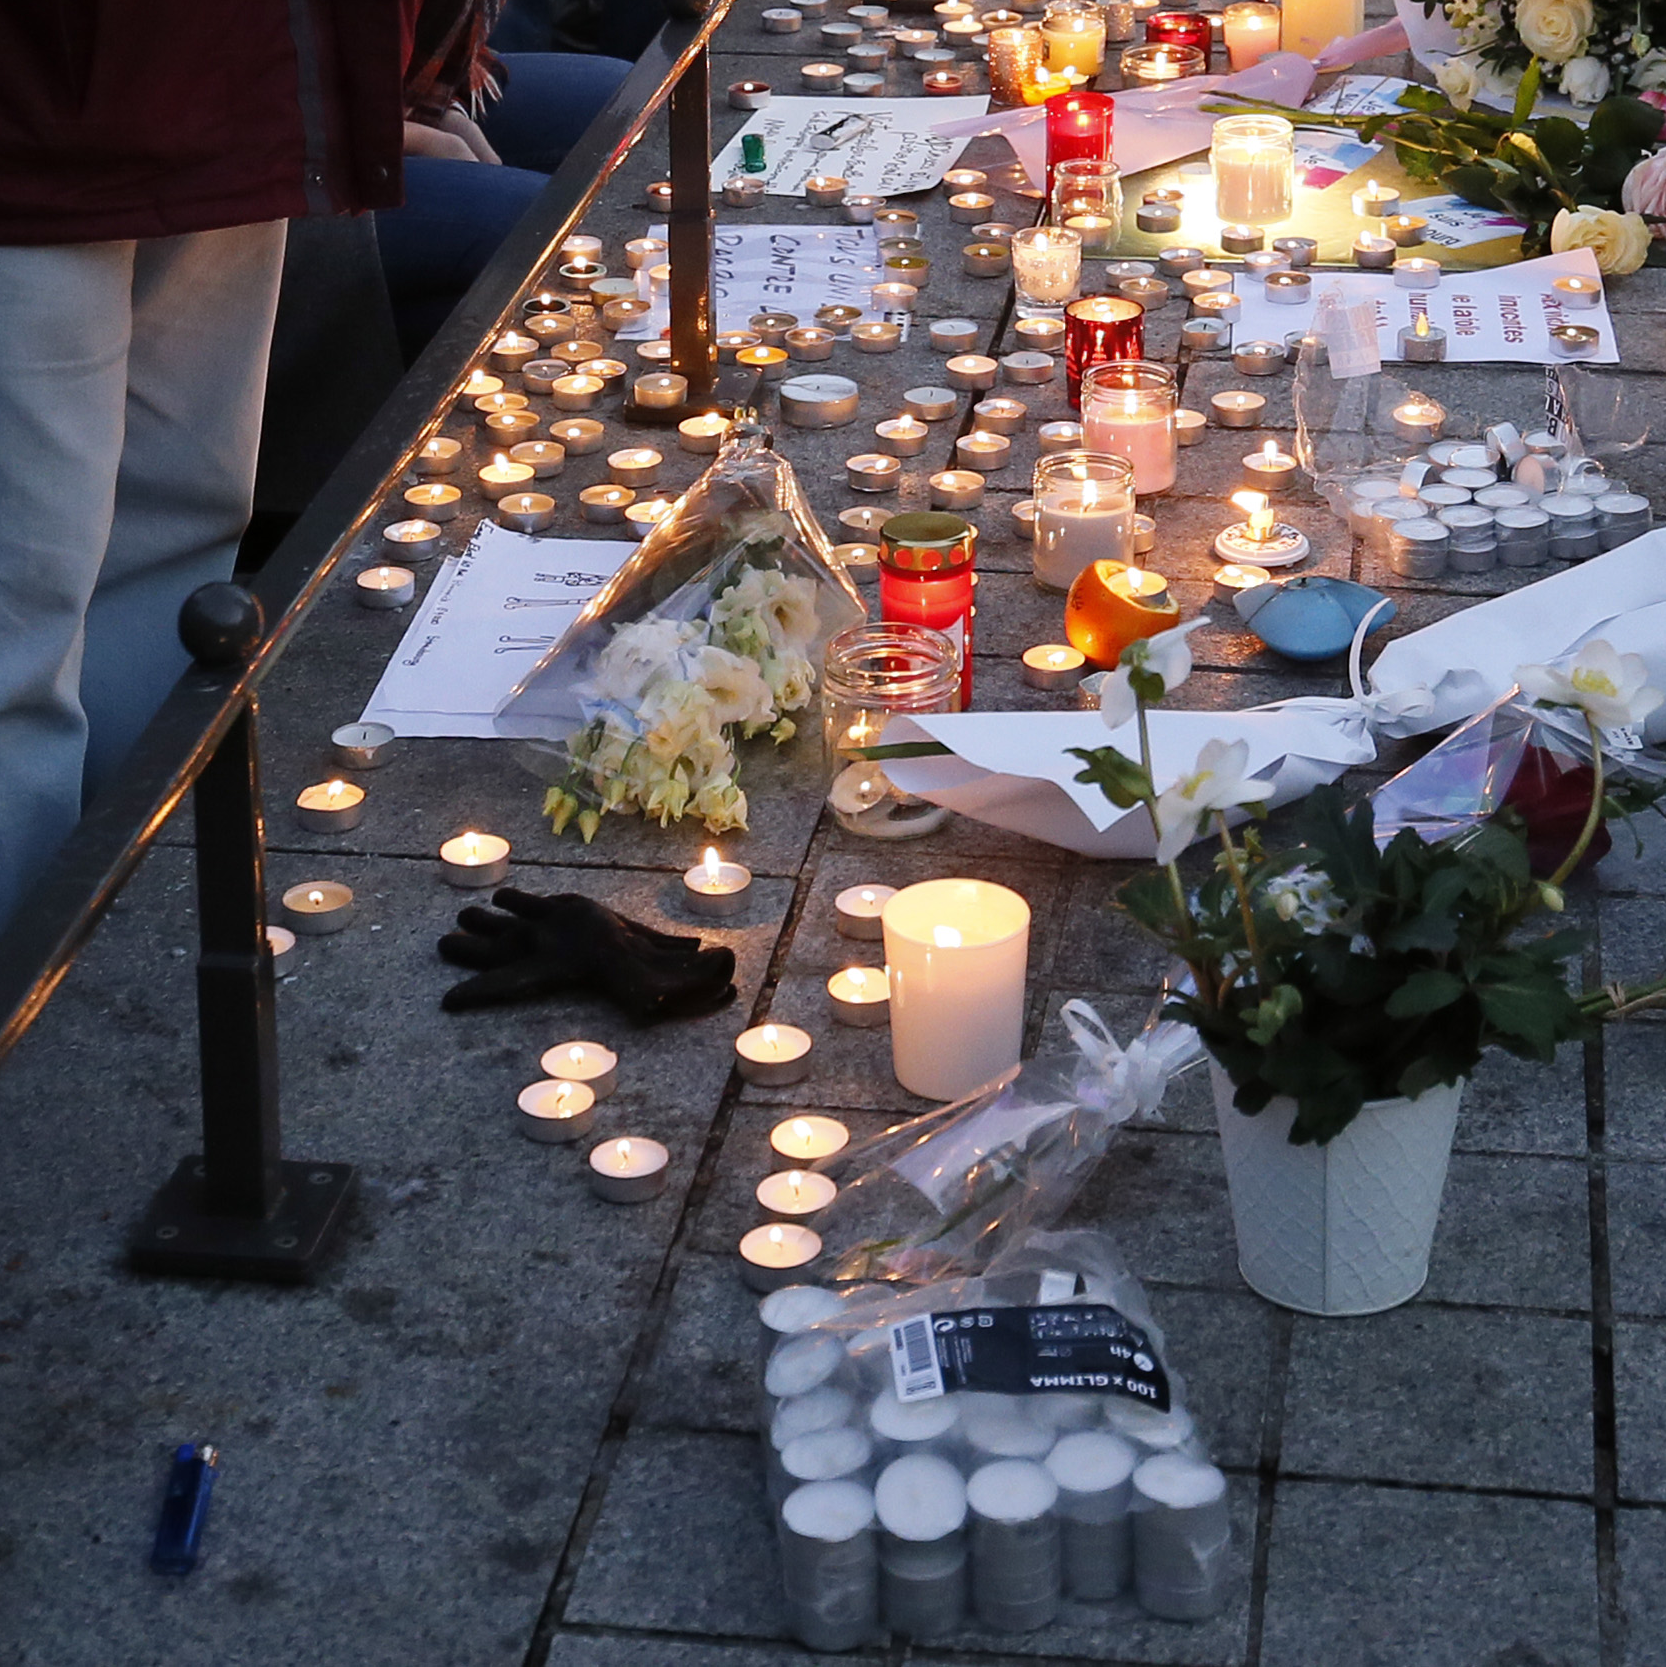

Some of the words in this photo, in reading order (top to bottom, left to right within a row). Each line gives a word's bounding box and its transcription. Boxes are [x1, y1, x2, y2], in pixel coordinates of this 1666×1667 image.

[829, 229, 866, 266] TOUS
[762, 234, 801, 295] CONTRE
[820, 272, 856, 307] UNI
[1110, 1343, 1132, 1359] 4h
[1030, 1375, 1109, 1387] GLIMMA
[1126, 1379, 1157, 1399] 100
